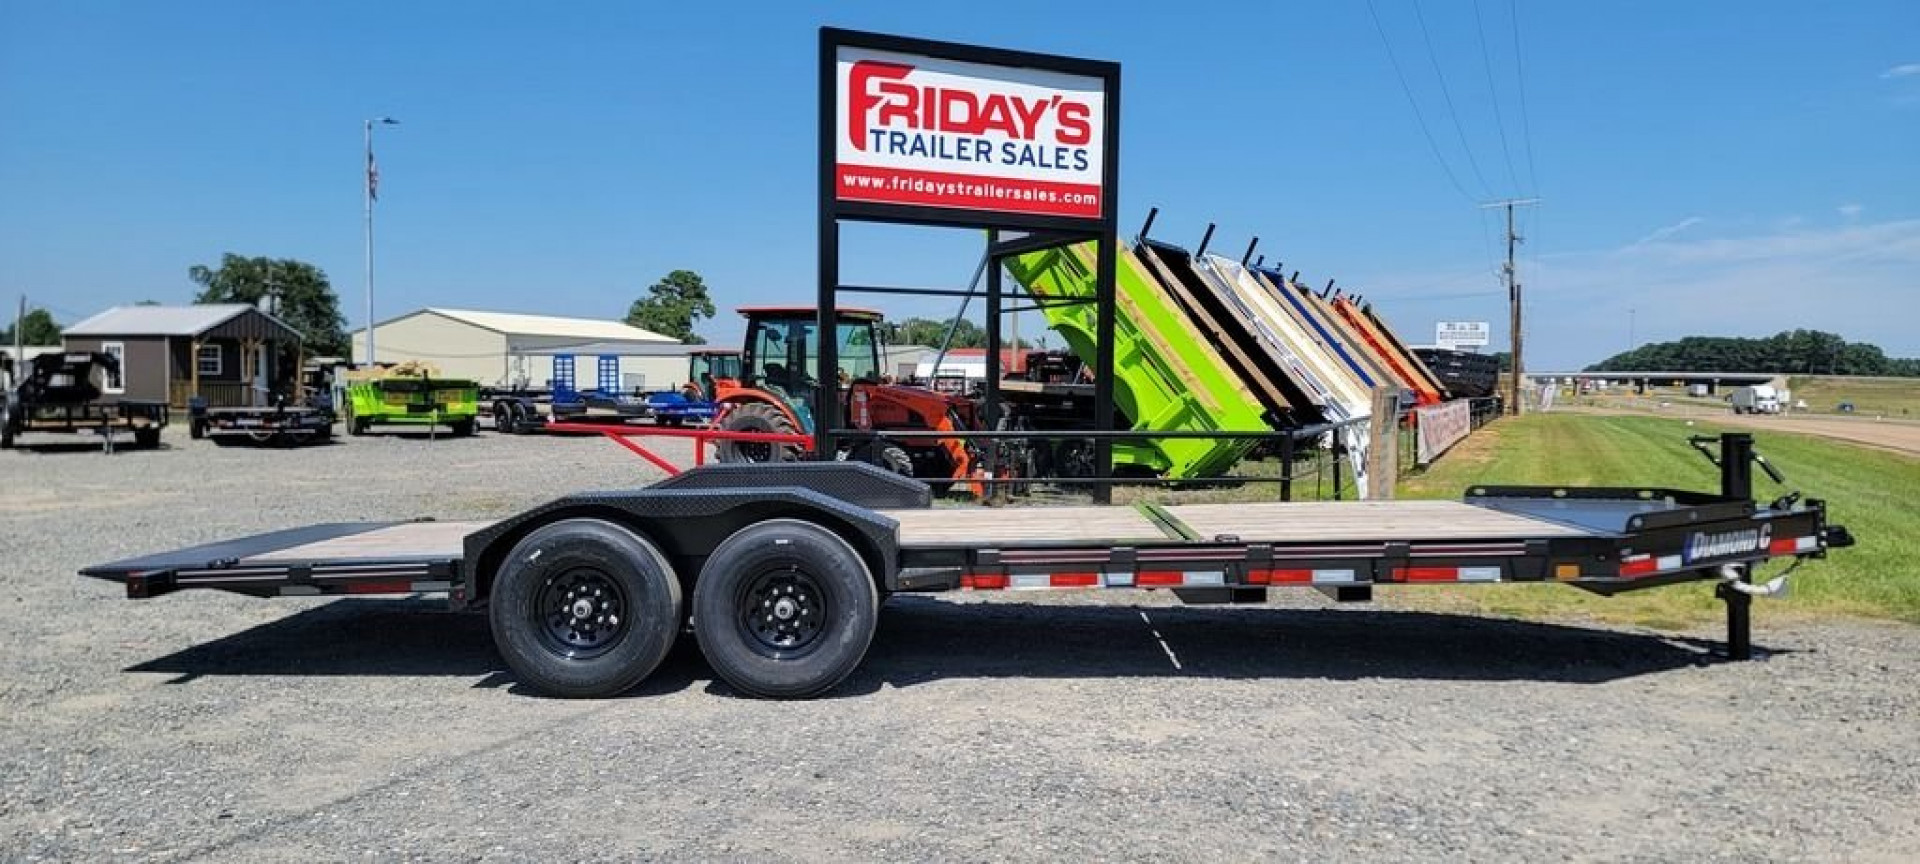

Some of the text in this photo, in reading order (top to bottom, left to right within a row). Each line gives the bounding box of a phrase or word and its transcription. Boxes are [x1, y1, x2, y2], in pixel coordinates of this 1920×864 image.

[849, 60, 1092, 151] FRIDAY'S
[870, 129, 1089, 171] TRAILER SALES
[843, 174, 1096, 205] www.fridaystrailersales.com
